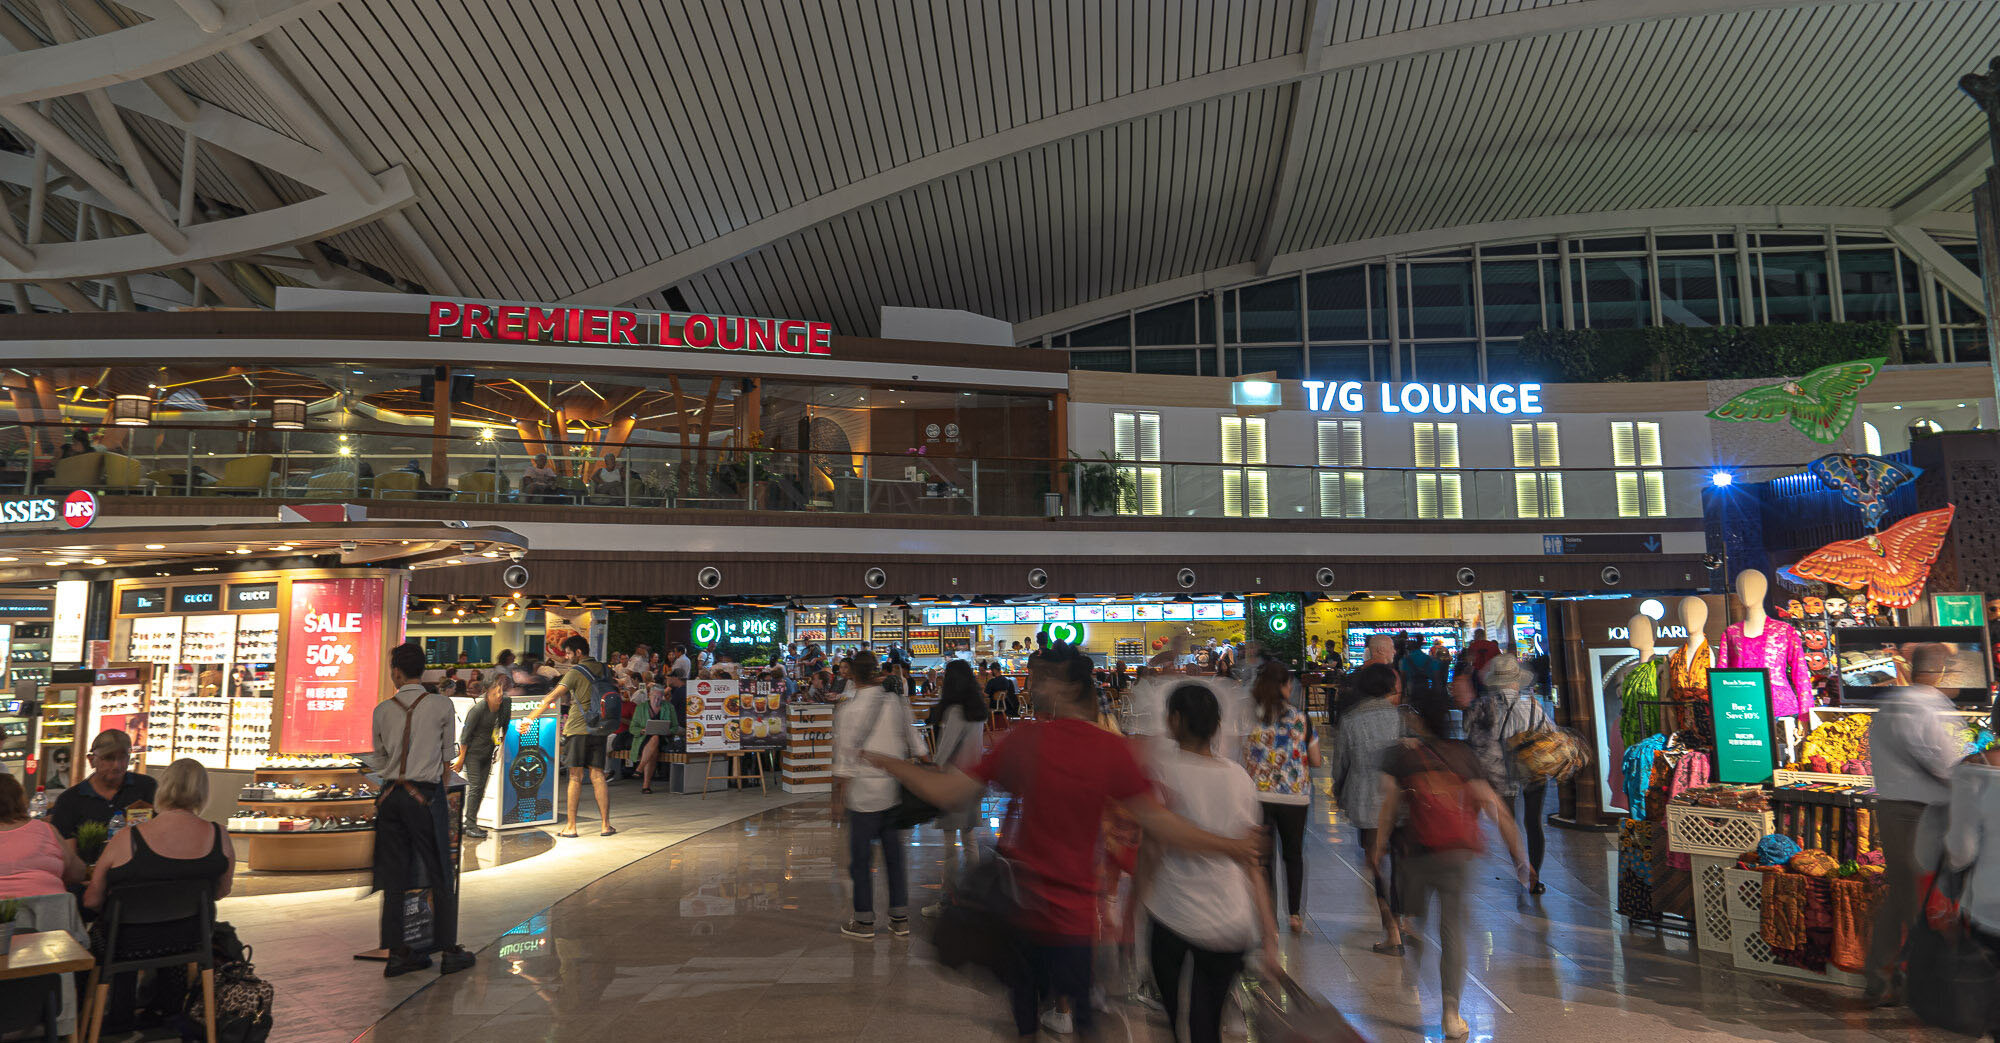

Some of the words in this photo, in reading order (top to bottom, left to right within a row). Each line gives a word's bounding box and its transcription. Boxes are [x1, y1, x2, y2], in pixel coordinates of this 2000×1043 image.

[429, 301, 639, 346] PREMIER
[659, 313, 832, 356] LOUNGE
[1302, 380, 1364, 412] T/G
[1381, 382, 1543, 414] LOUNGE
[0, 499, 56, 523] SSES
[65, 502, 93, 517] DFS
[184, 594, 213, 603] GUCCI
[239, 591, 270, 601] GUCCI
[304, 613, 362, 633] SALE
[306, 644, 354, 665] 50%
[315, 666, 340, 677] OFF
[1731, 703, 1746, 712] Buy
[1743, 712, 1760, 720] 10%
